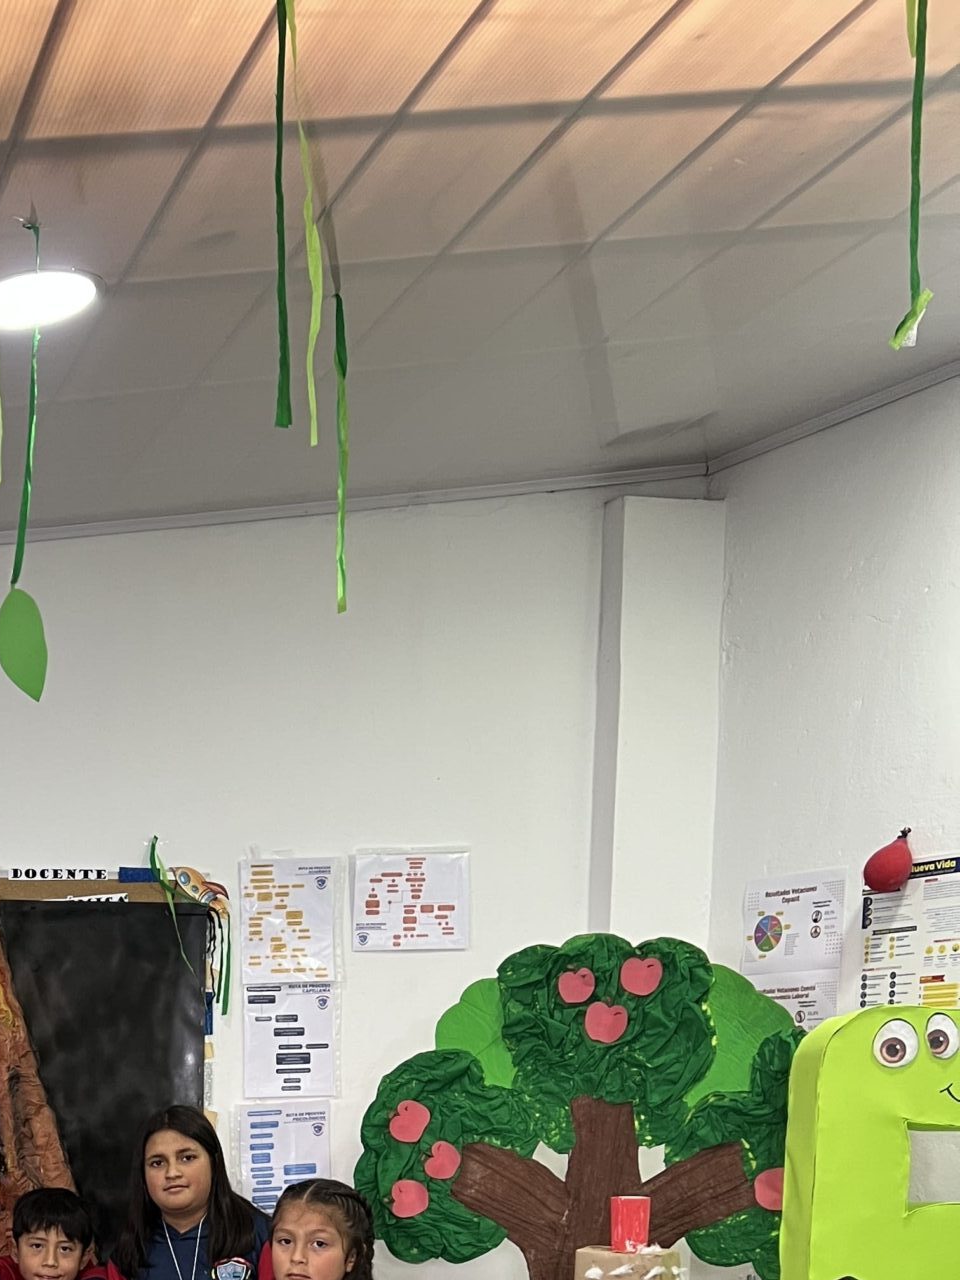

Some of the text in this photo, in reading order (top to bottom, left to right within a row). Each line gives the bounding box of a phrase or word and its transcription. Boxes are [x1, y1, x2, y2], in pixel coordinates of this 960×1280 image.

[912, 863, 935, 873] ueva
[936, 859, 957, 869] Vida
[11, 868, 107, 880] DOCENTE
